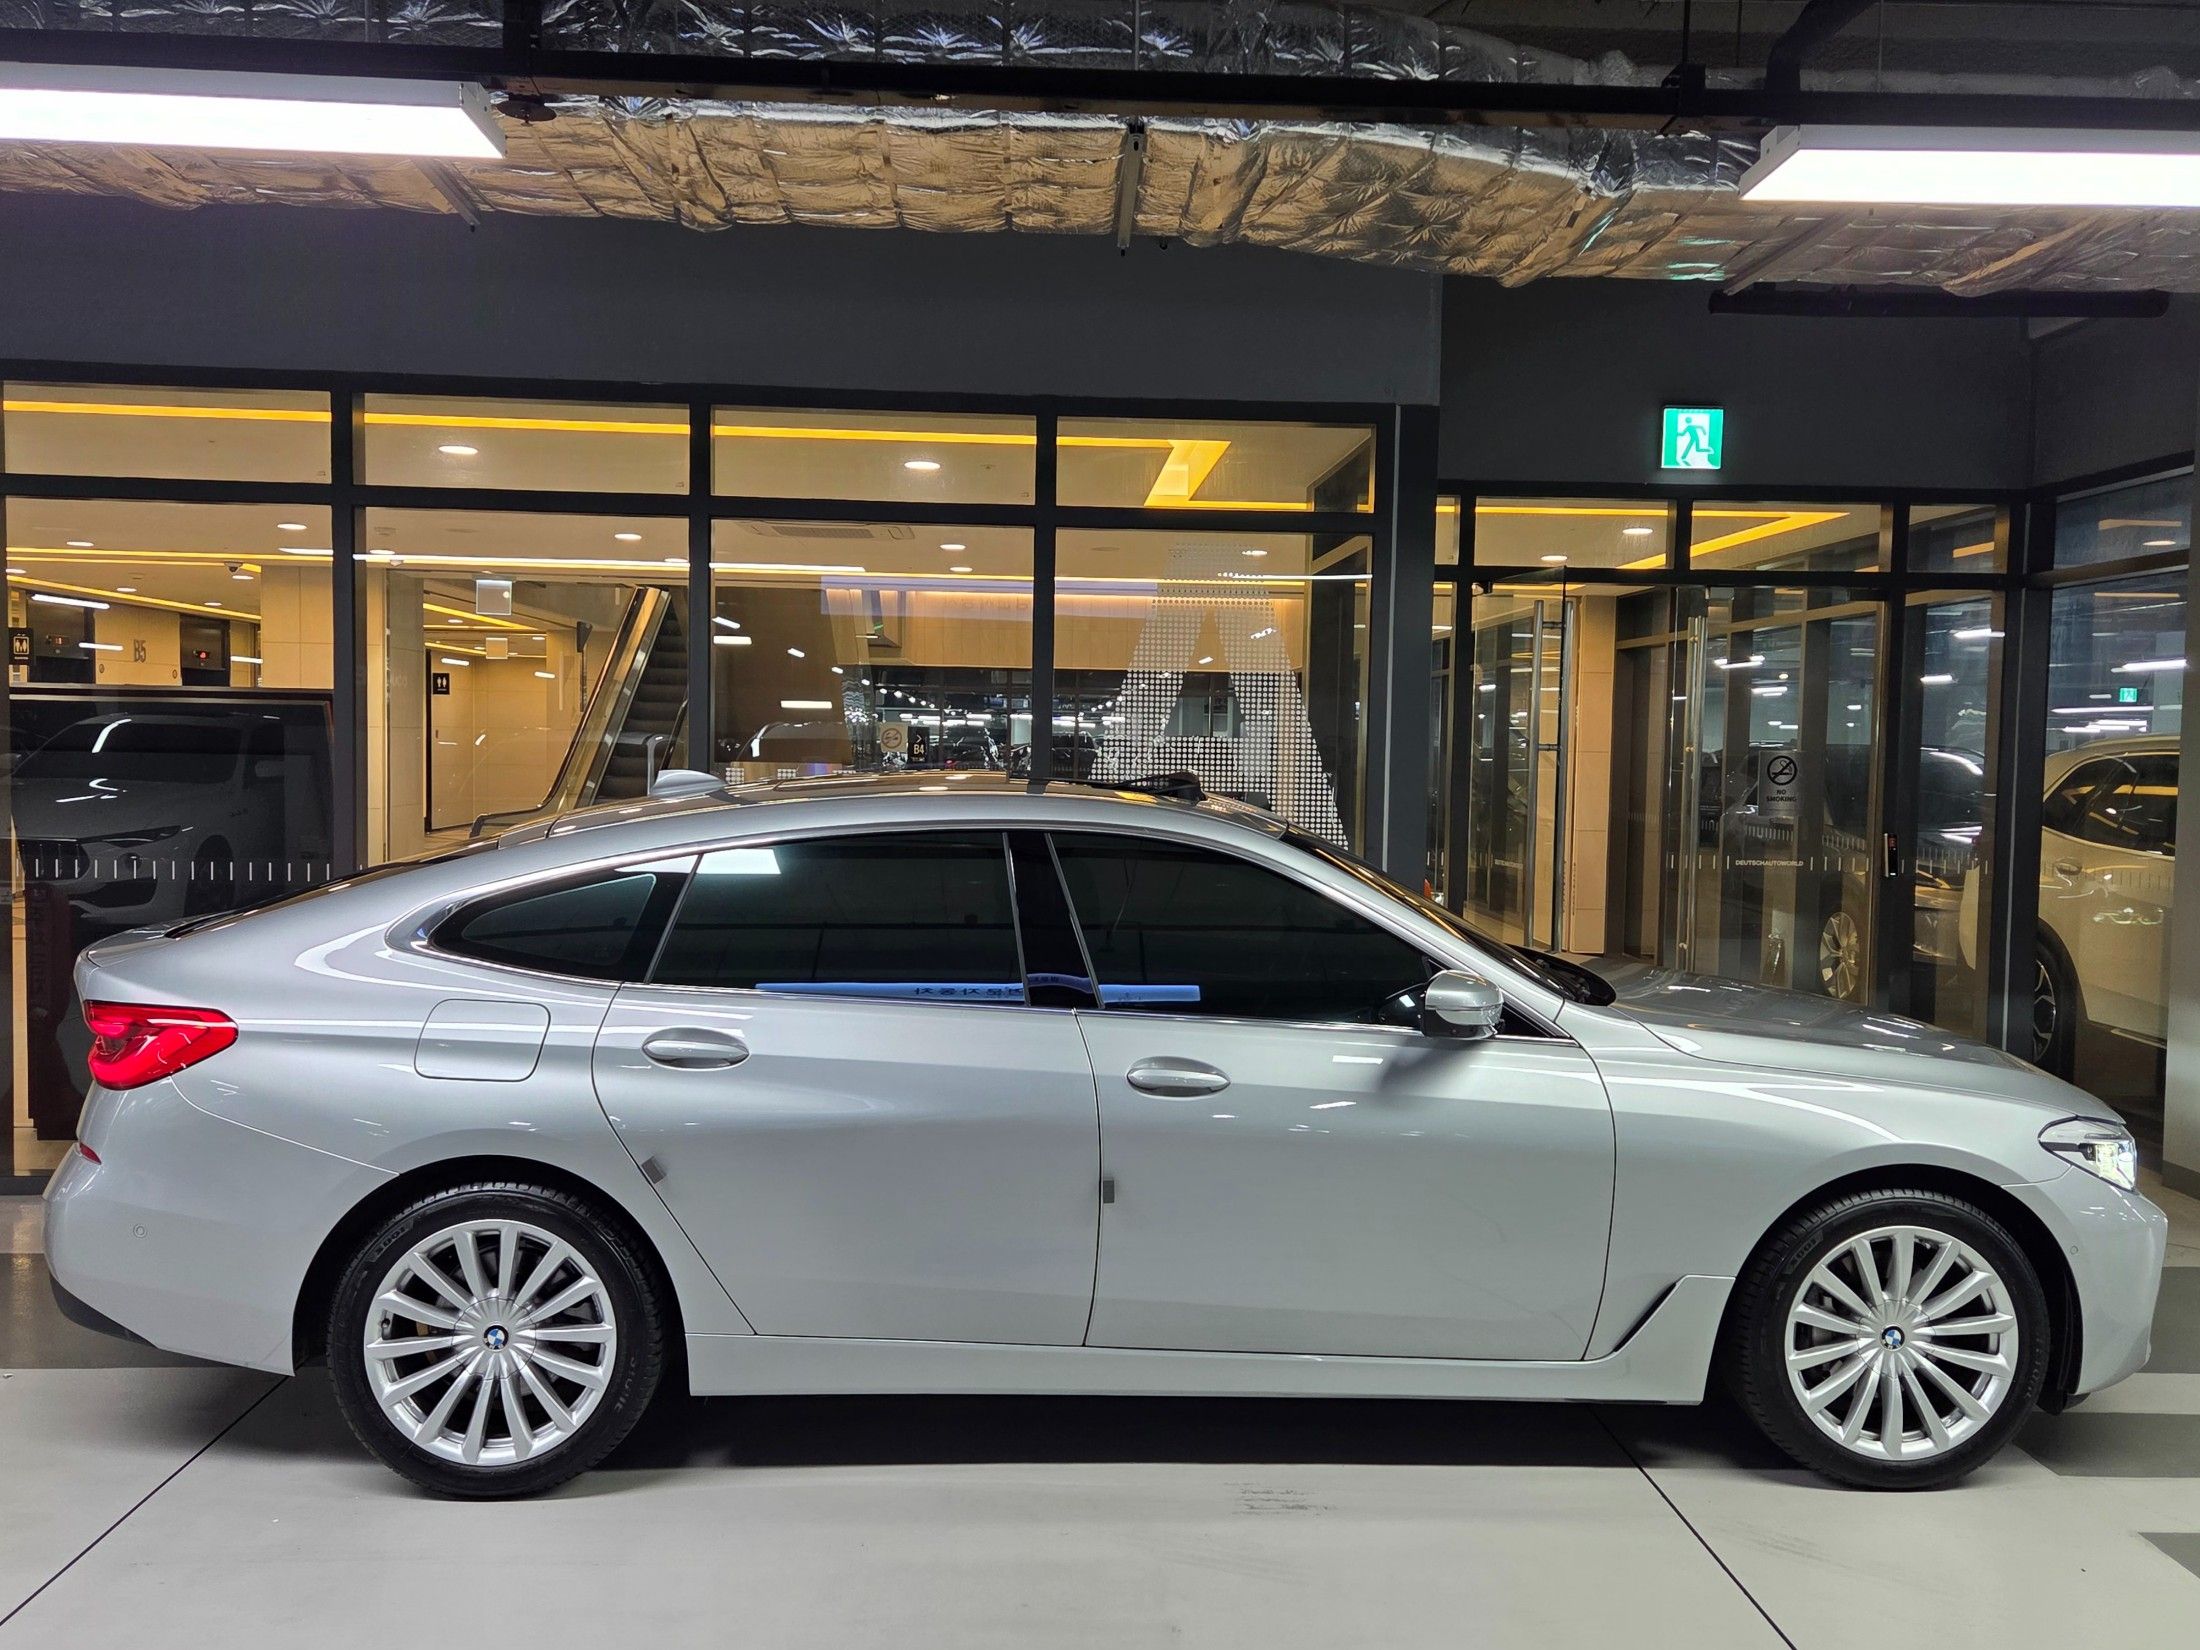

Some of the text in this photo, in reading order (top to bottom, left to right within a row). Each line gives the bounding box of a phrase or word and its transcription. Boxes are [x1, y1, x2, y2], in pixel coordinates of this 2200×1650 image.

[133, 639, 147, 663] B5
[913, 744, 925, 755] B4
[1735, 859, 1804, 867] DEUTSCHAUTOWORLD
